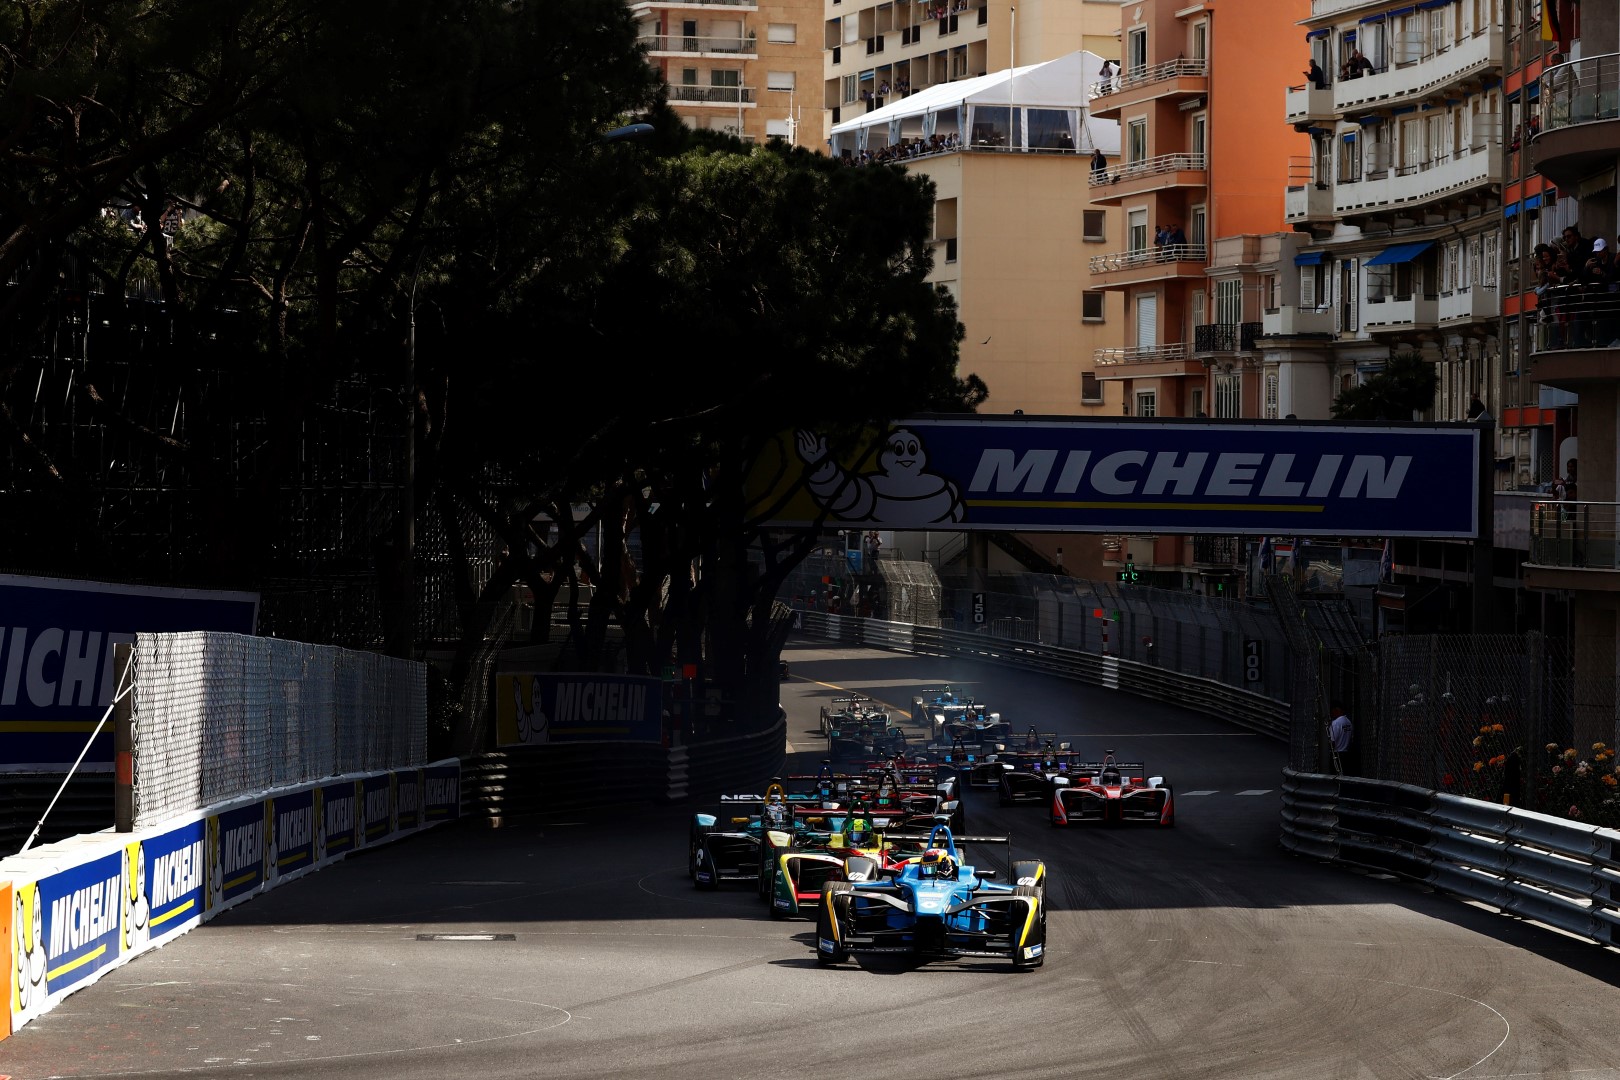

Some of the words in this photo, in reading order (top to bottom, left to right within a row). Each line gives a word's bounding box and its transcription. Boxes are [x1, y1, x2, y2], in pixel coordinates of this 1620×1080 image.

[967, 448, 1413, 499] MICHELIN
[974, 593, 984, 623] 150
[0, 626, 136, 707] ICH
[1247, 641, 1260, 681] 100
[554, 682, 647, 721] MICHELIN
[366, 786, 389, 824] MICHELIN
[425, 777, 458, 805] MICHELIN
[279, 805, 312, 853] MICHELIN
[326, 796, 354, 836] MICHELIN
[224, 819, 263, 875] MICHELIN
[152, 839, 205, 910] MICHELIN
[50, 874, 121, 960] MICHELIN
